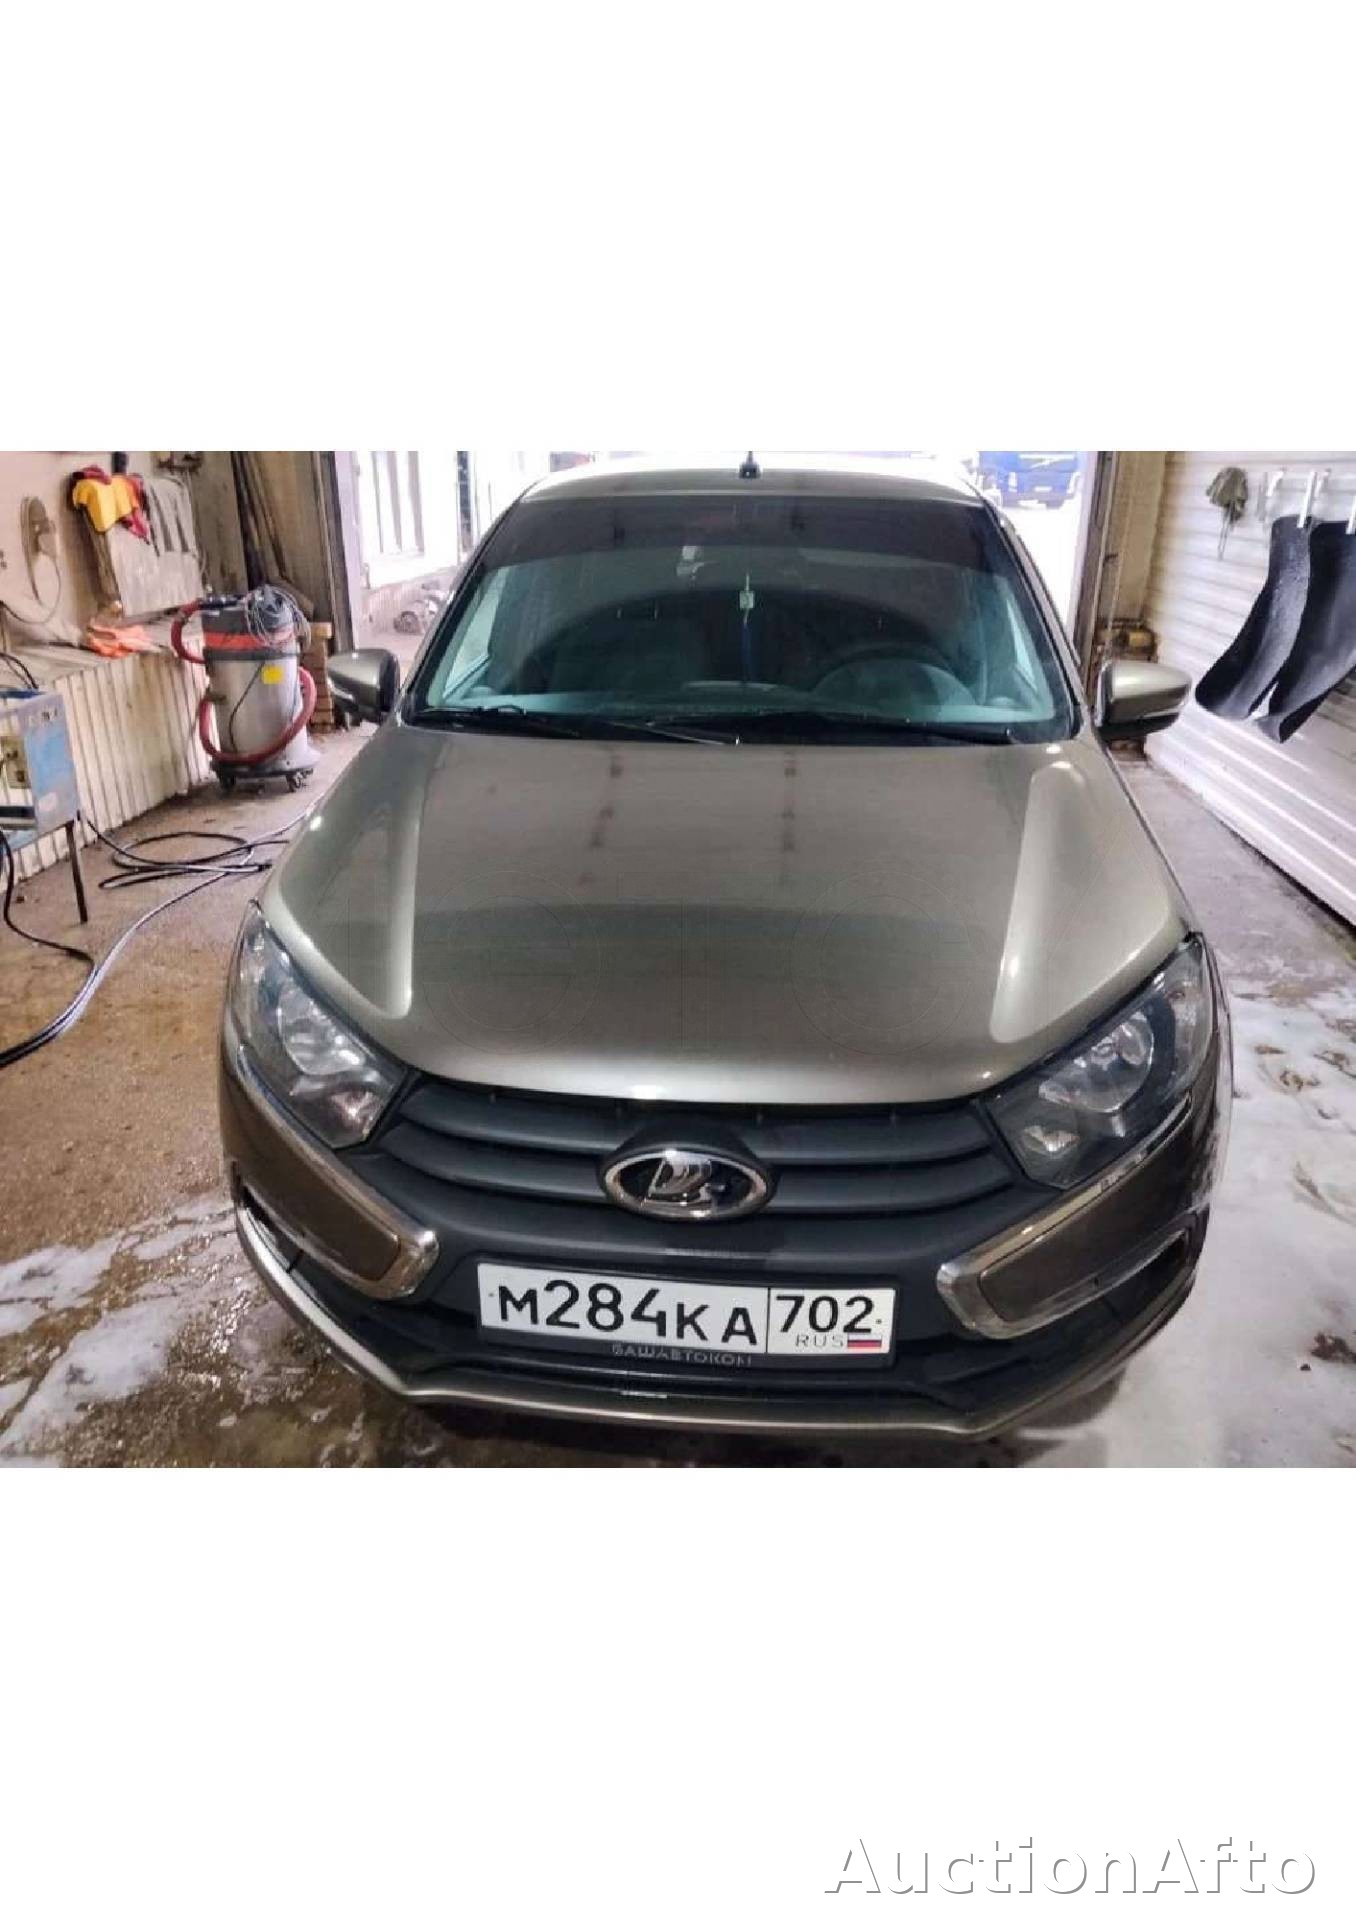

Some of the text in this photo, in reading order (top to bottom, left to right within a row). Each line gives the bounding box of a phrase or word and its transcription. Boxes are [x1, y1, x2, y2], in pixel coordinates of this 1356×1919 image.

[498, 1279, 875, 1346] М284КА 702
[794, 1333, 844, 1349] RUS
